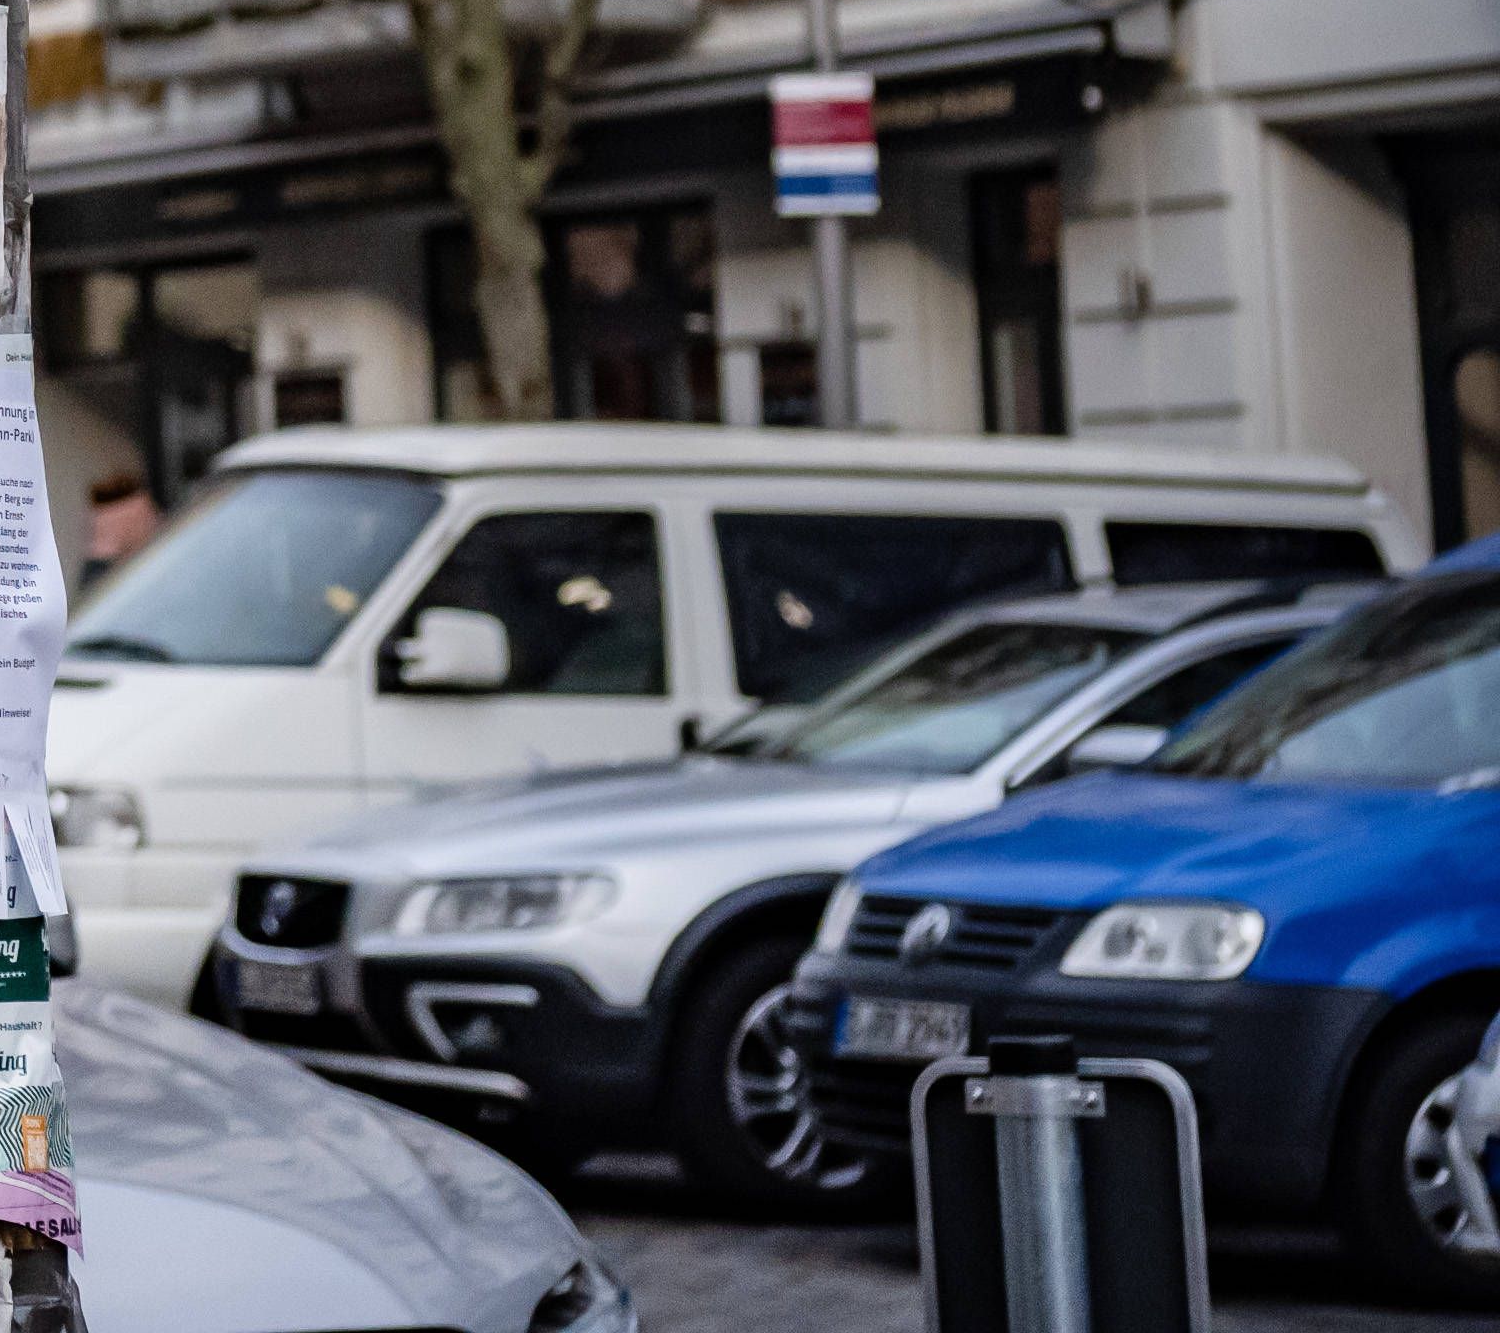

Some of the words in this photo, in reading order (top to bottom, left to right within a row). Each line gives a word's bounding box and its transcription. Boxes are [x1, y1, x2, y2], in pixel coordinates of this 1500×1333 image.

[4, 493, 21, 506] Berg
[0, 561, 10, 570] zu
[22, 578, 37, 588] bin
[13, 593, 43, 605] großen
[0, 1021, 43, 1031] Haushalt?
